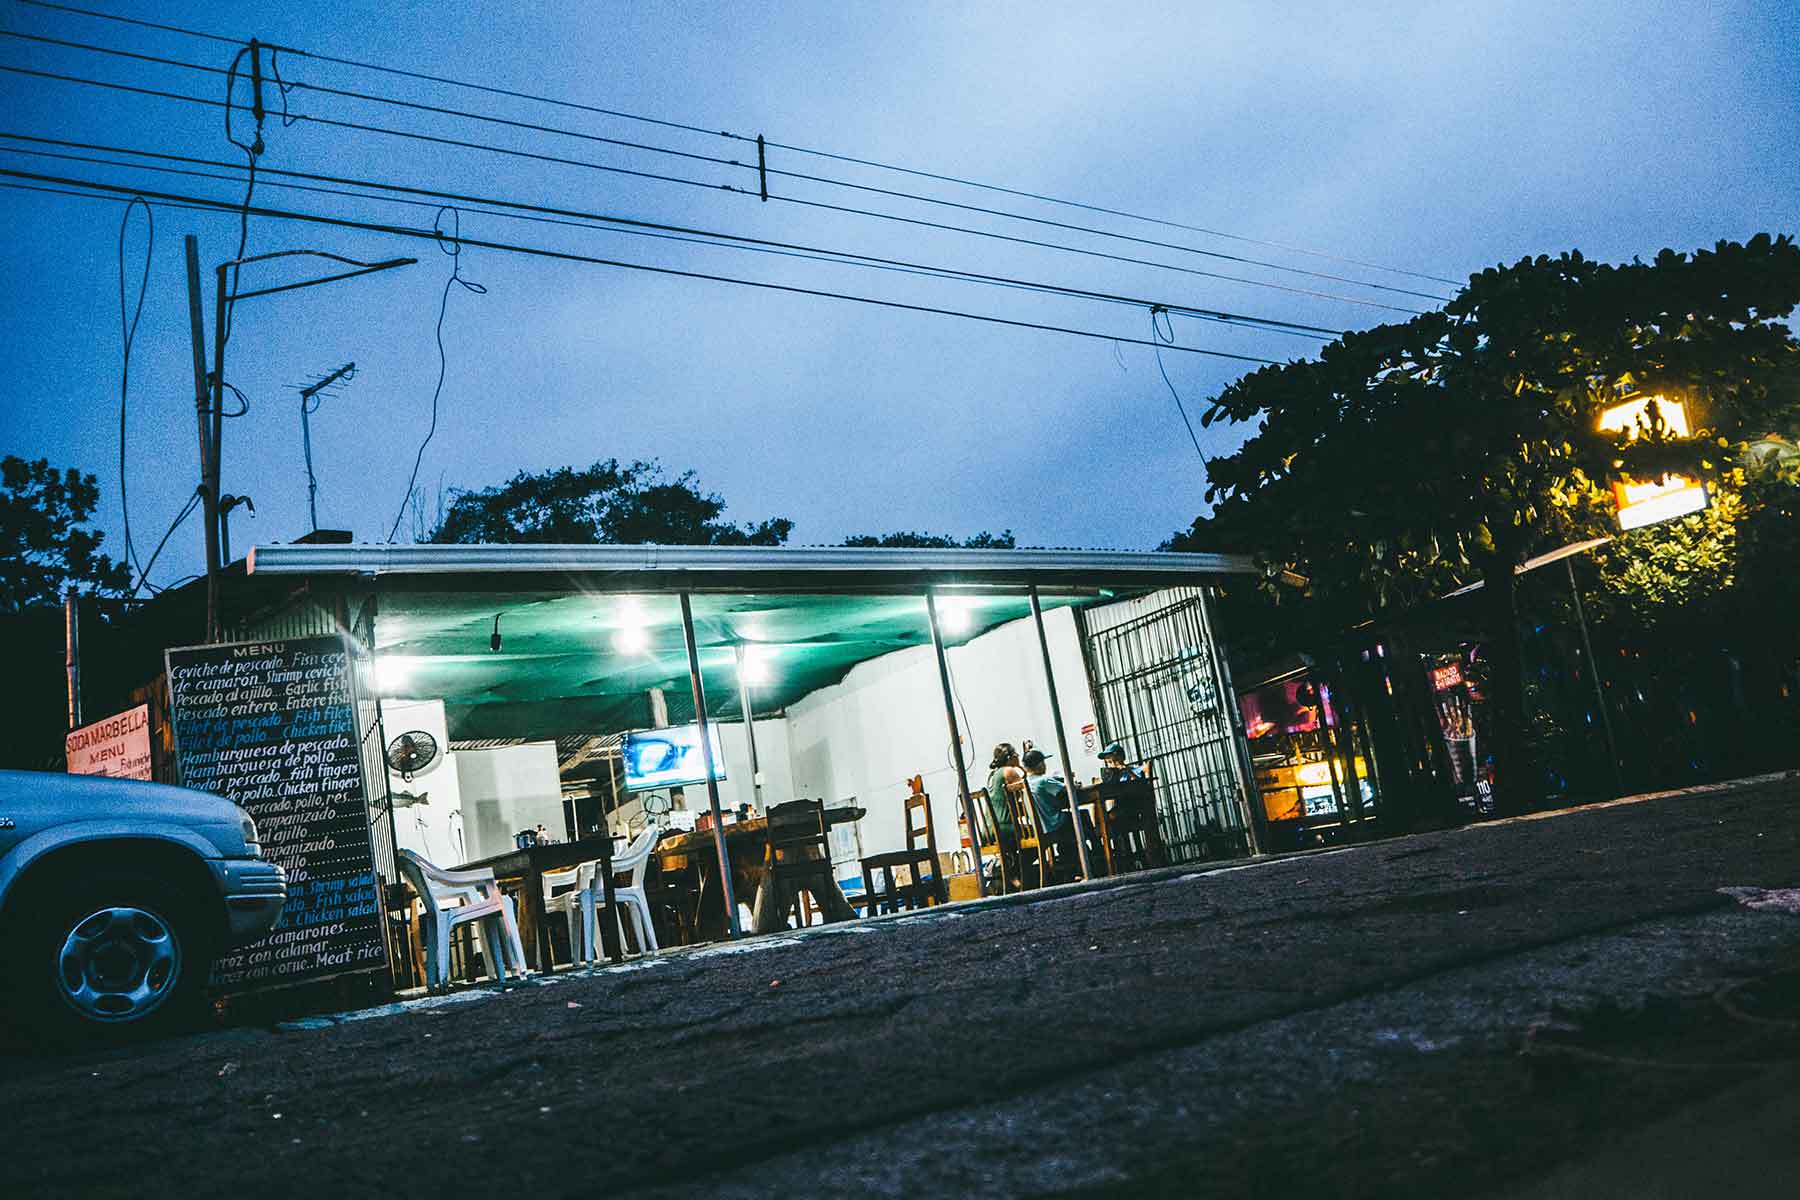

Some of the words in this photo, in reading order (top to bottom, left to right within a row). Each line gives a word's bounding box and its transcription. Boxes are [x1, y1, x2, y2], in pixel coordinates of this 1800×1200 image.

[234, 643, 285, 657] MENU
[171, 662, 219, 679] Ceviche
[220, 660, 234, 674] de
[173, 679, 191, 693] de
[267, 668, 303, 684] Shrimp
[176, 690, 223, 707] Pescado
[225, 688, 239, 702] al
[67, 733, 90, 754] SODA
[89, 743, 125, 764] MENU
[182, 745, 277, 765] Hamburguesa
[280, 739, 295, 754] de
[184, 758, 281, 779] Hamburguesa
[285, 754, 300, 767] de
[277, 781, 319, 796] Chicken
[263, 836, 334, 860] mpanizado
[269, 922, 345, 945] camarones
[249, 951, 272, 965] con
[357, 944, 382, 960] rice
